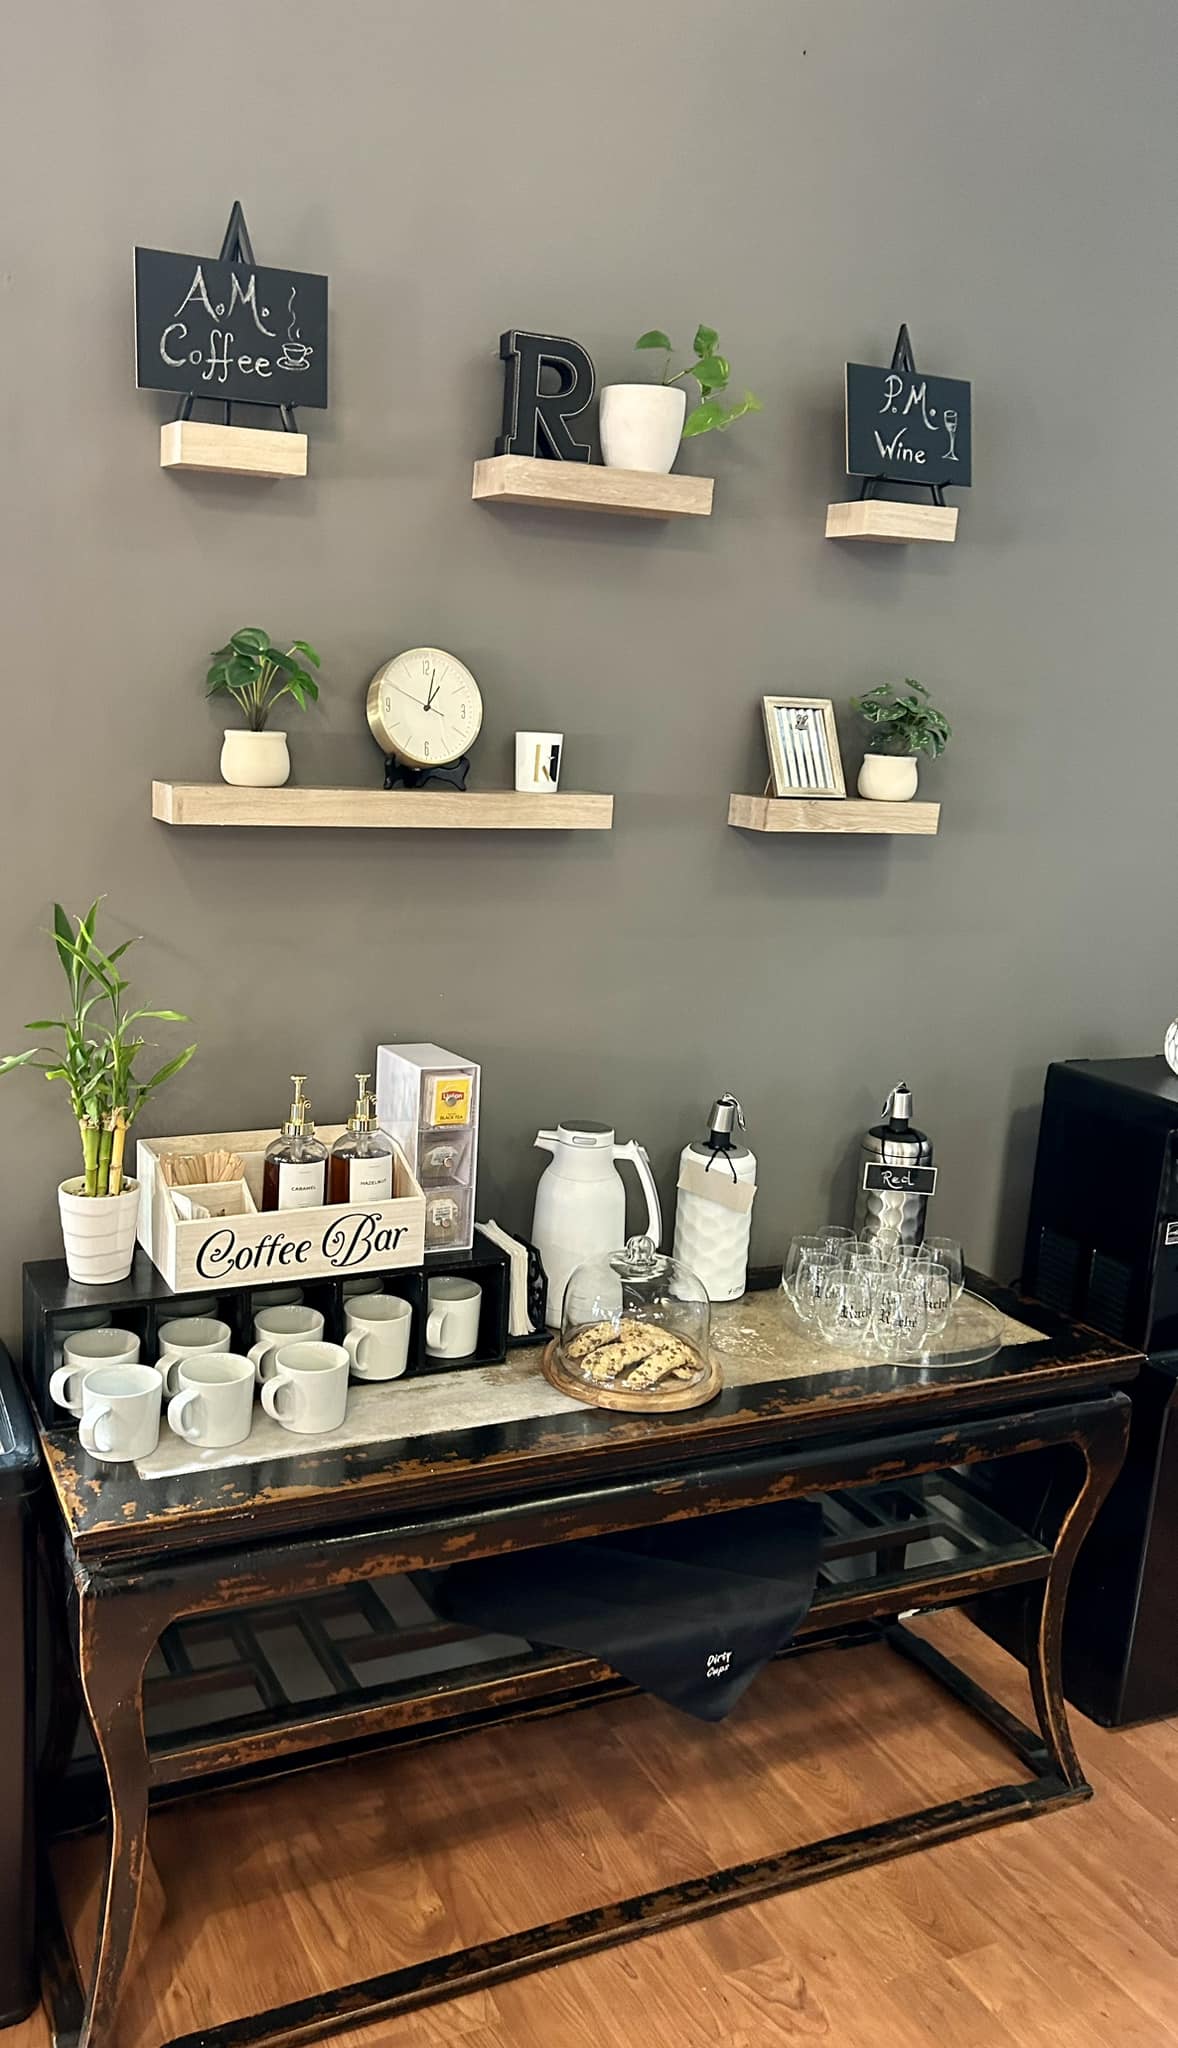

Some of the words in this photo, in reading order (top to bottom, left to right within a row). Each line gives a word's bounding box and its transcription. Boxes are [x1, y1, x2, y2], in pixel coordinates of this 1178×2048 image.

[174, 265, 276, 337] A.M.
[160, 323, 273, 383] Coffee
[495, 329, 595, 465] R
[880, 374, 940, 430] P.M.
[874, 427, 927, 464] Wine
[422, 660, 431, 676] 12
[385, 697, 391, 713] 9
[460, 703, 467, 720] 3
[424, 741, 430, 757] 6
[881, 1170, 915, 1189] Red
[196, 1229, 312, 1279] Coffee
[322, 1213, 409, 1267] Bar
[707, 1651, 732, 1667] Dirty
[706, 1664, 730, 1677] Cups
